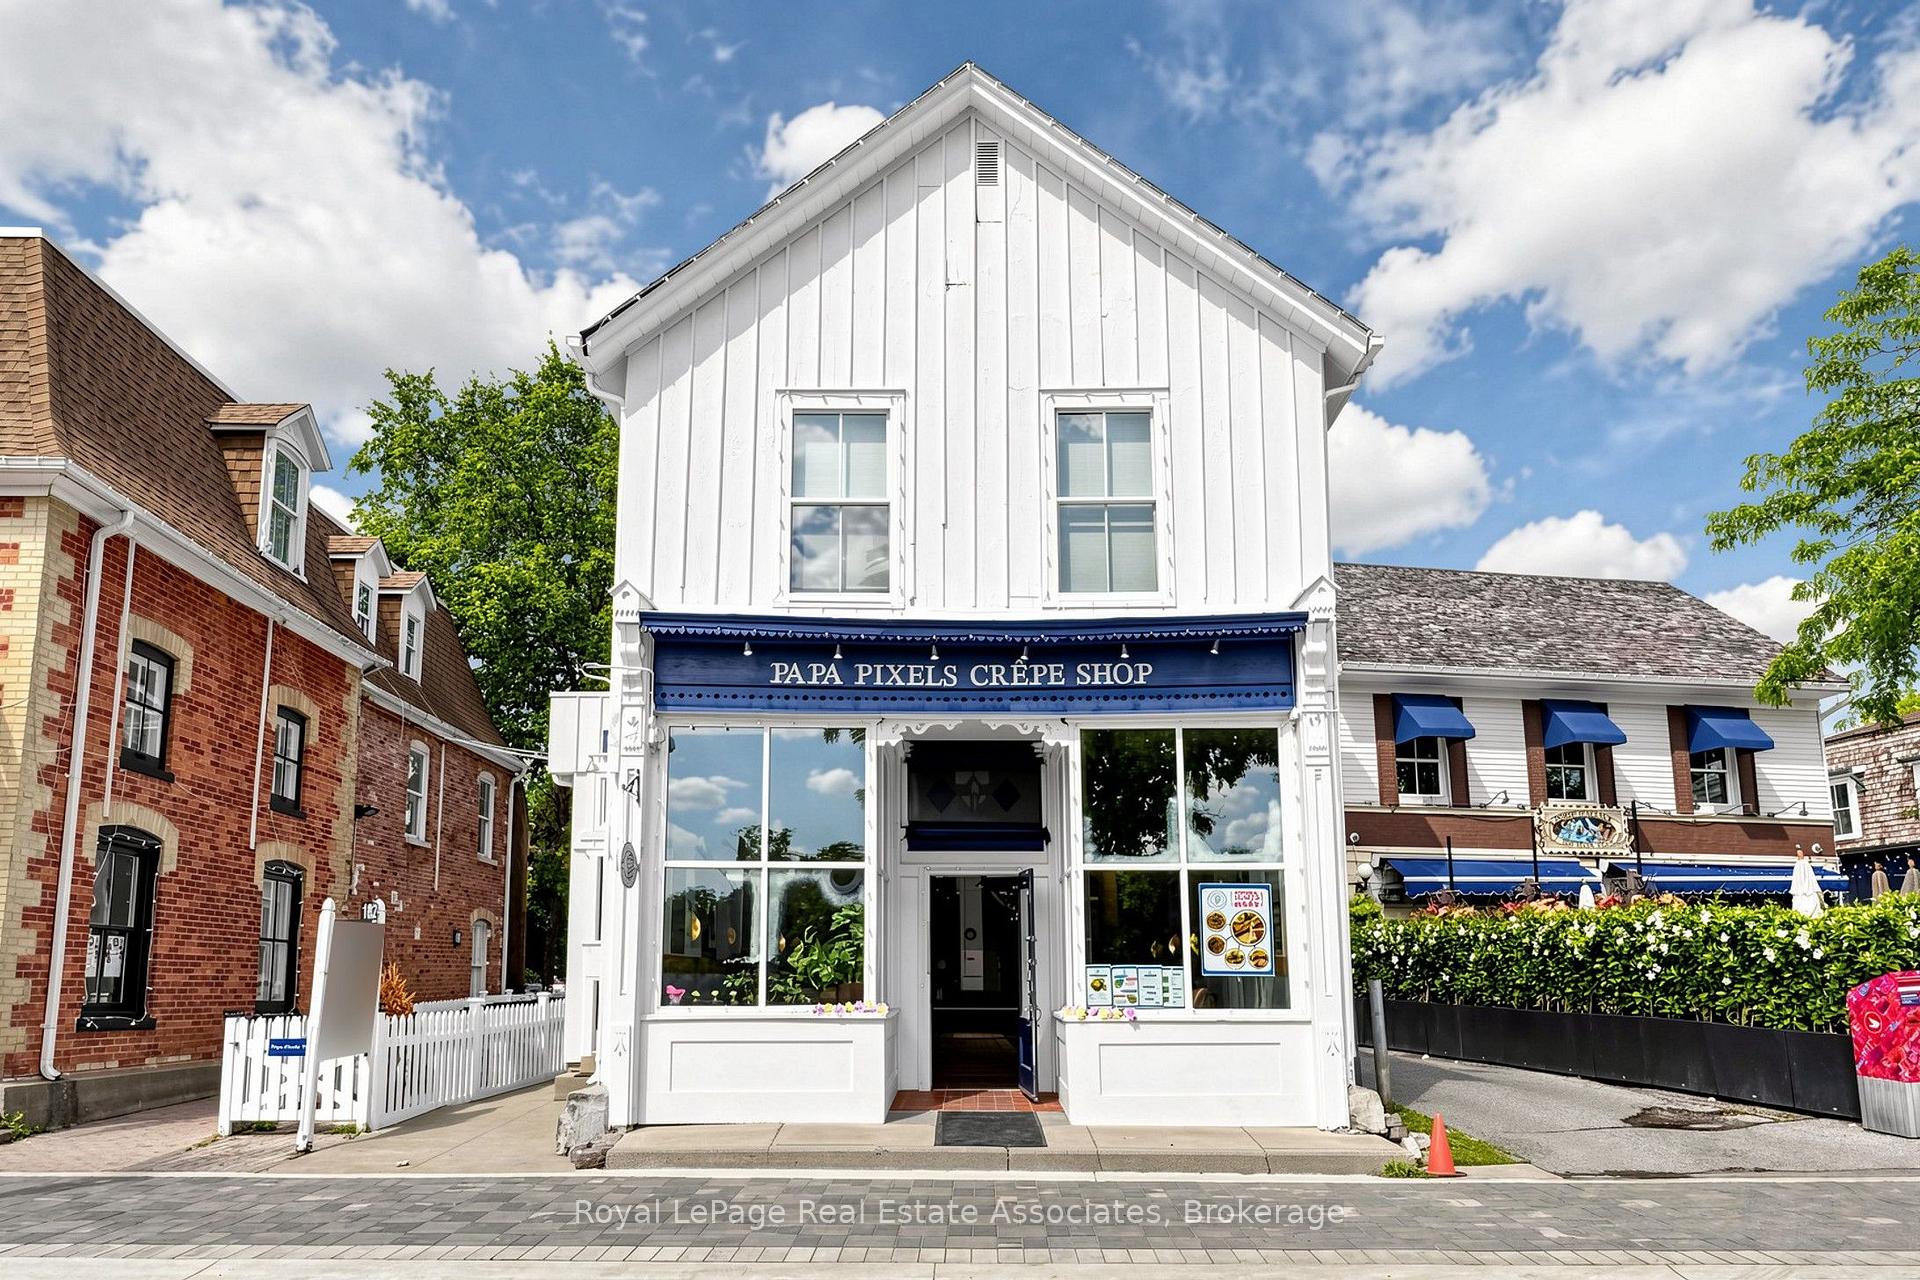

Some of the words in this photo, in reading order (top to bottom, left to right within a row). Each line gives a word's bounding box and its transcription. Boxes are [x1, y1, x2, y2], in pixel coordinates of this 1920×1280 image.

[770, 662, 844, 685] PAPA
[854, 663, 957, 687] PIXELS
[970, 658, 1065, 687] CRÊPE
[1076, 662, 1153, 686] SHOP
